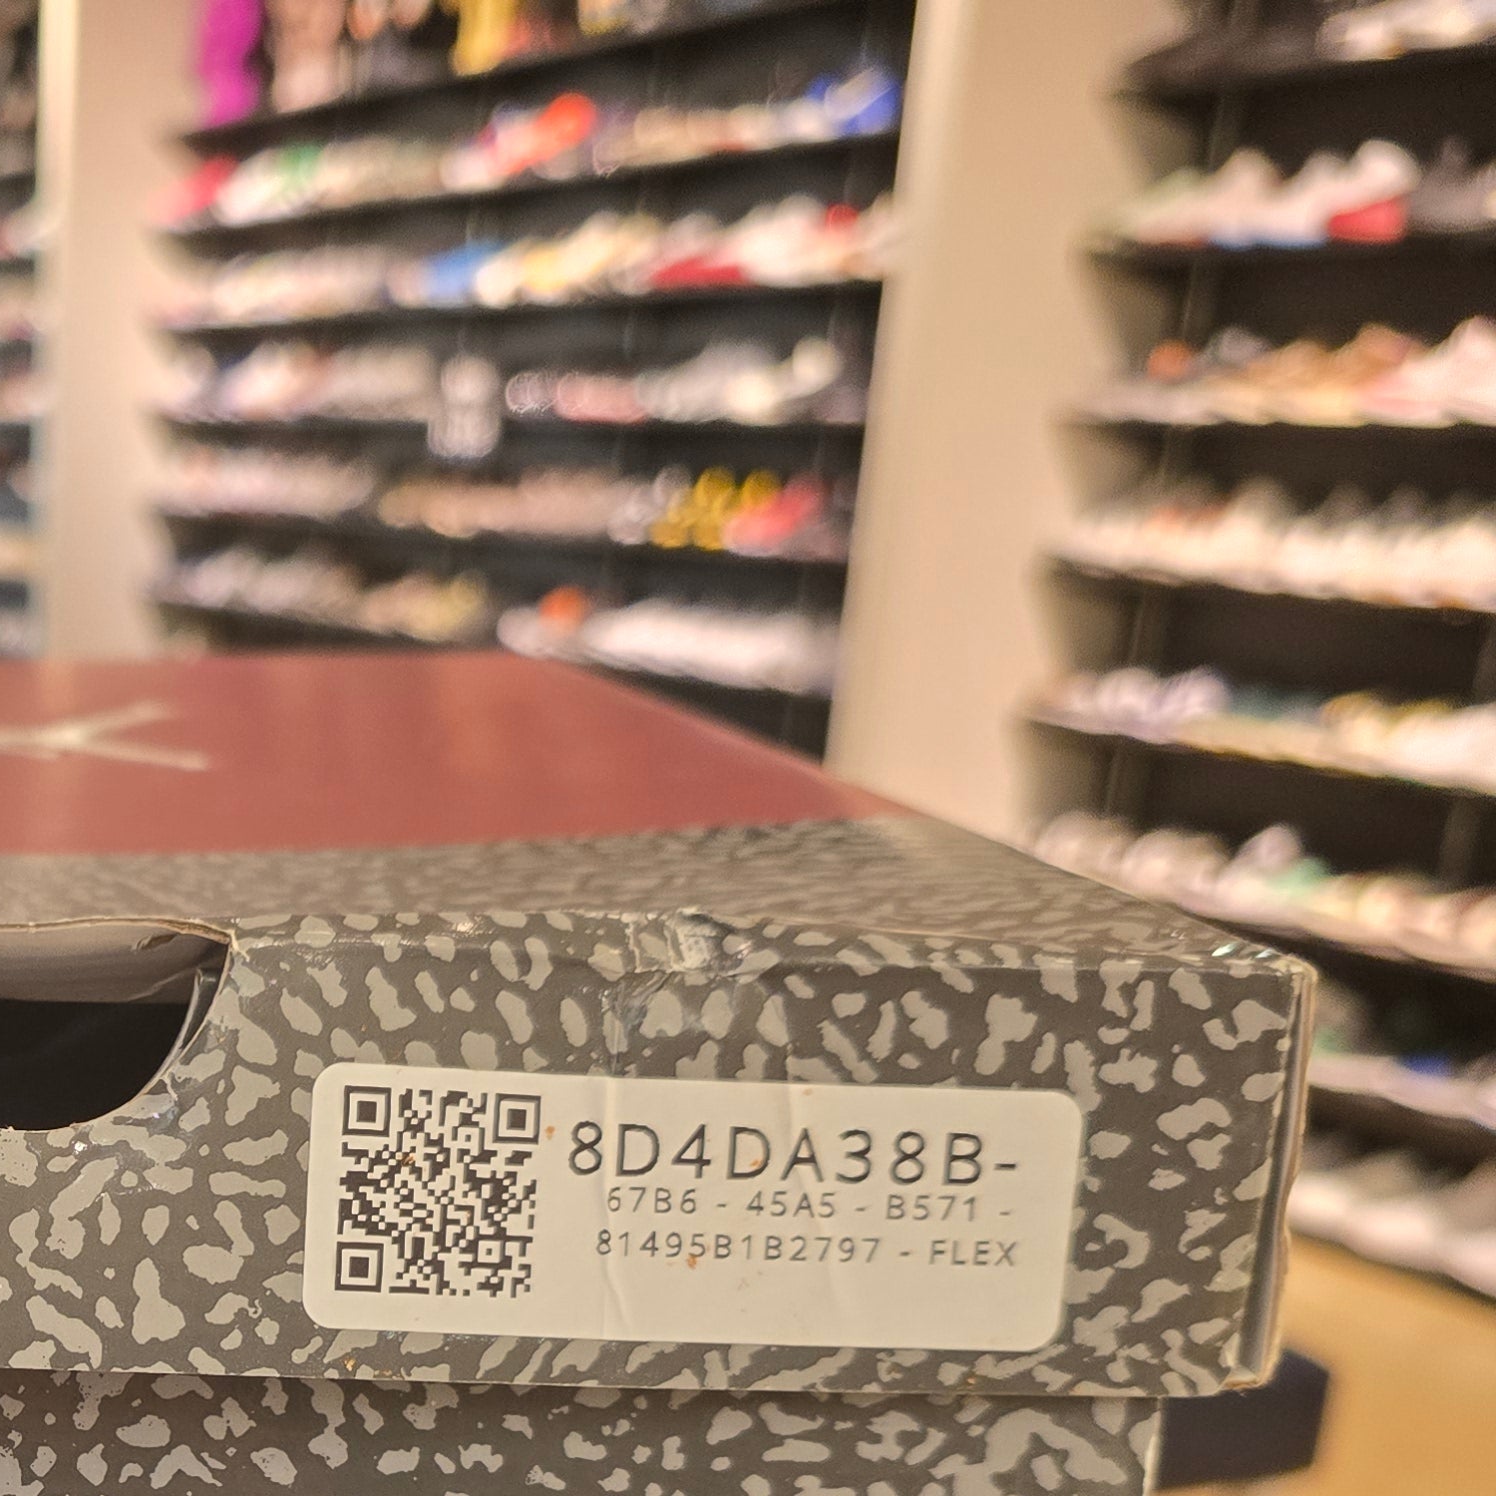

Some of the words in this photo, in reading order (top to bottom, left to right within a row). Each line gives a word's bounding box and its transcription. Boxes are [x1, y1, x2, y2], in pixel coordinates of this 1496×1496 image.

[568, 1120, 1017, 1185] 8D4DA38B-
[607, 1186, 697, 1214] 67B6
[746, 1191, 836, 1218] 45A5
[886, 1194, 977, 1221] B571
[596, 1229, 880, 1263] 81495B1B2797
[929, 1240, 1016, 1266] FLEX
